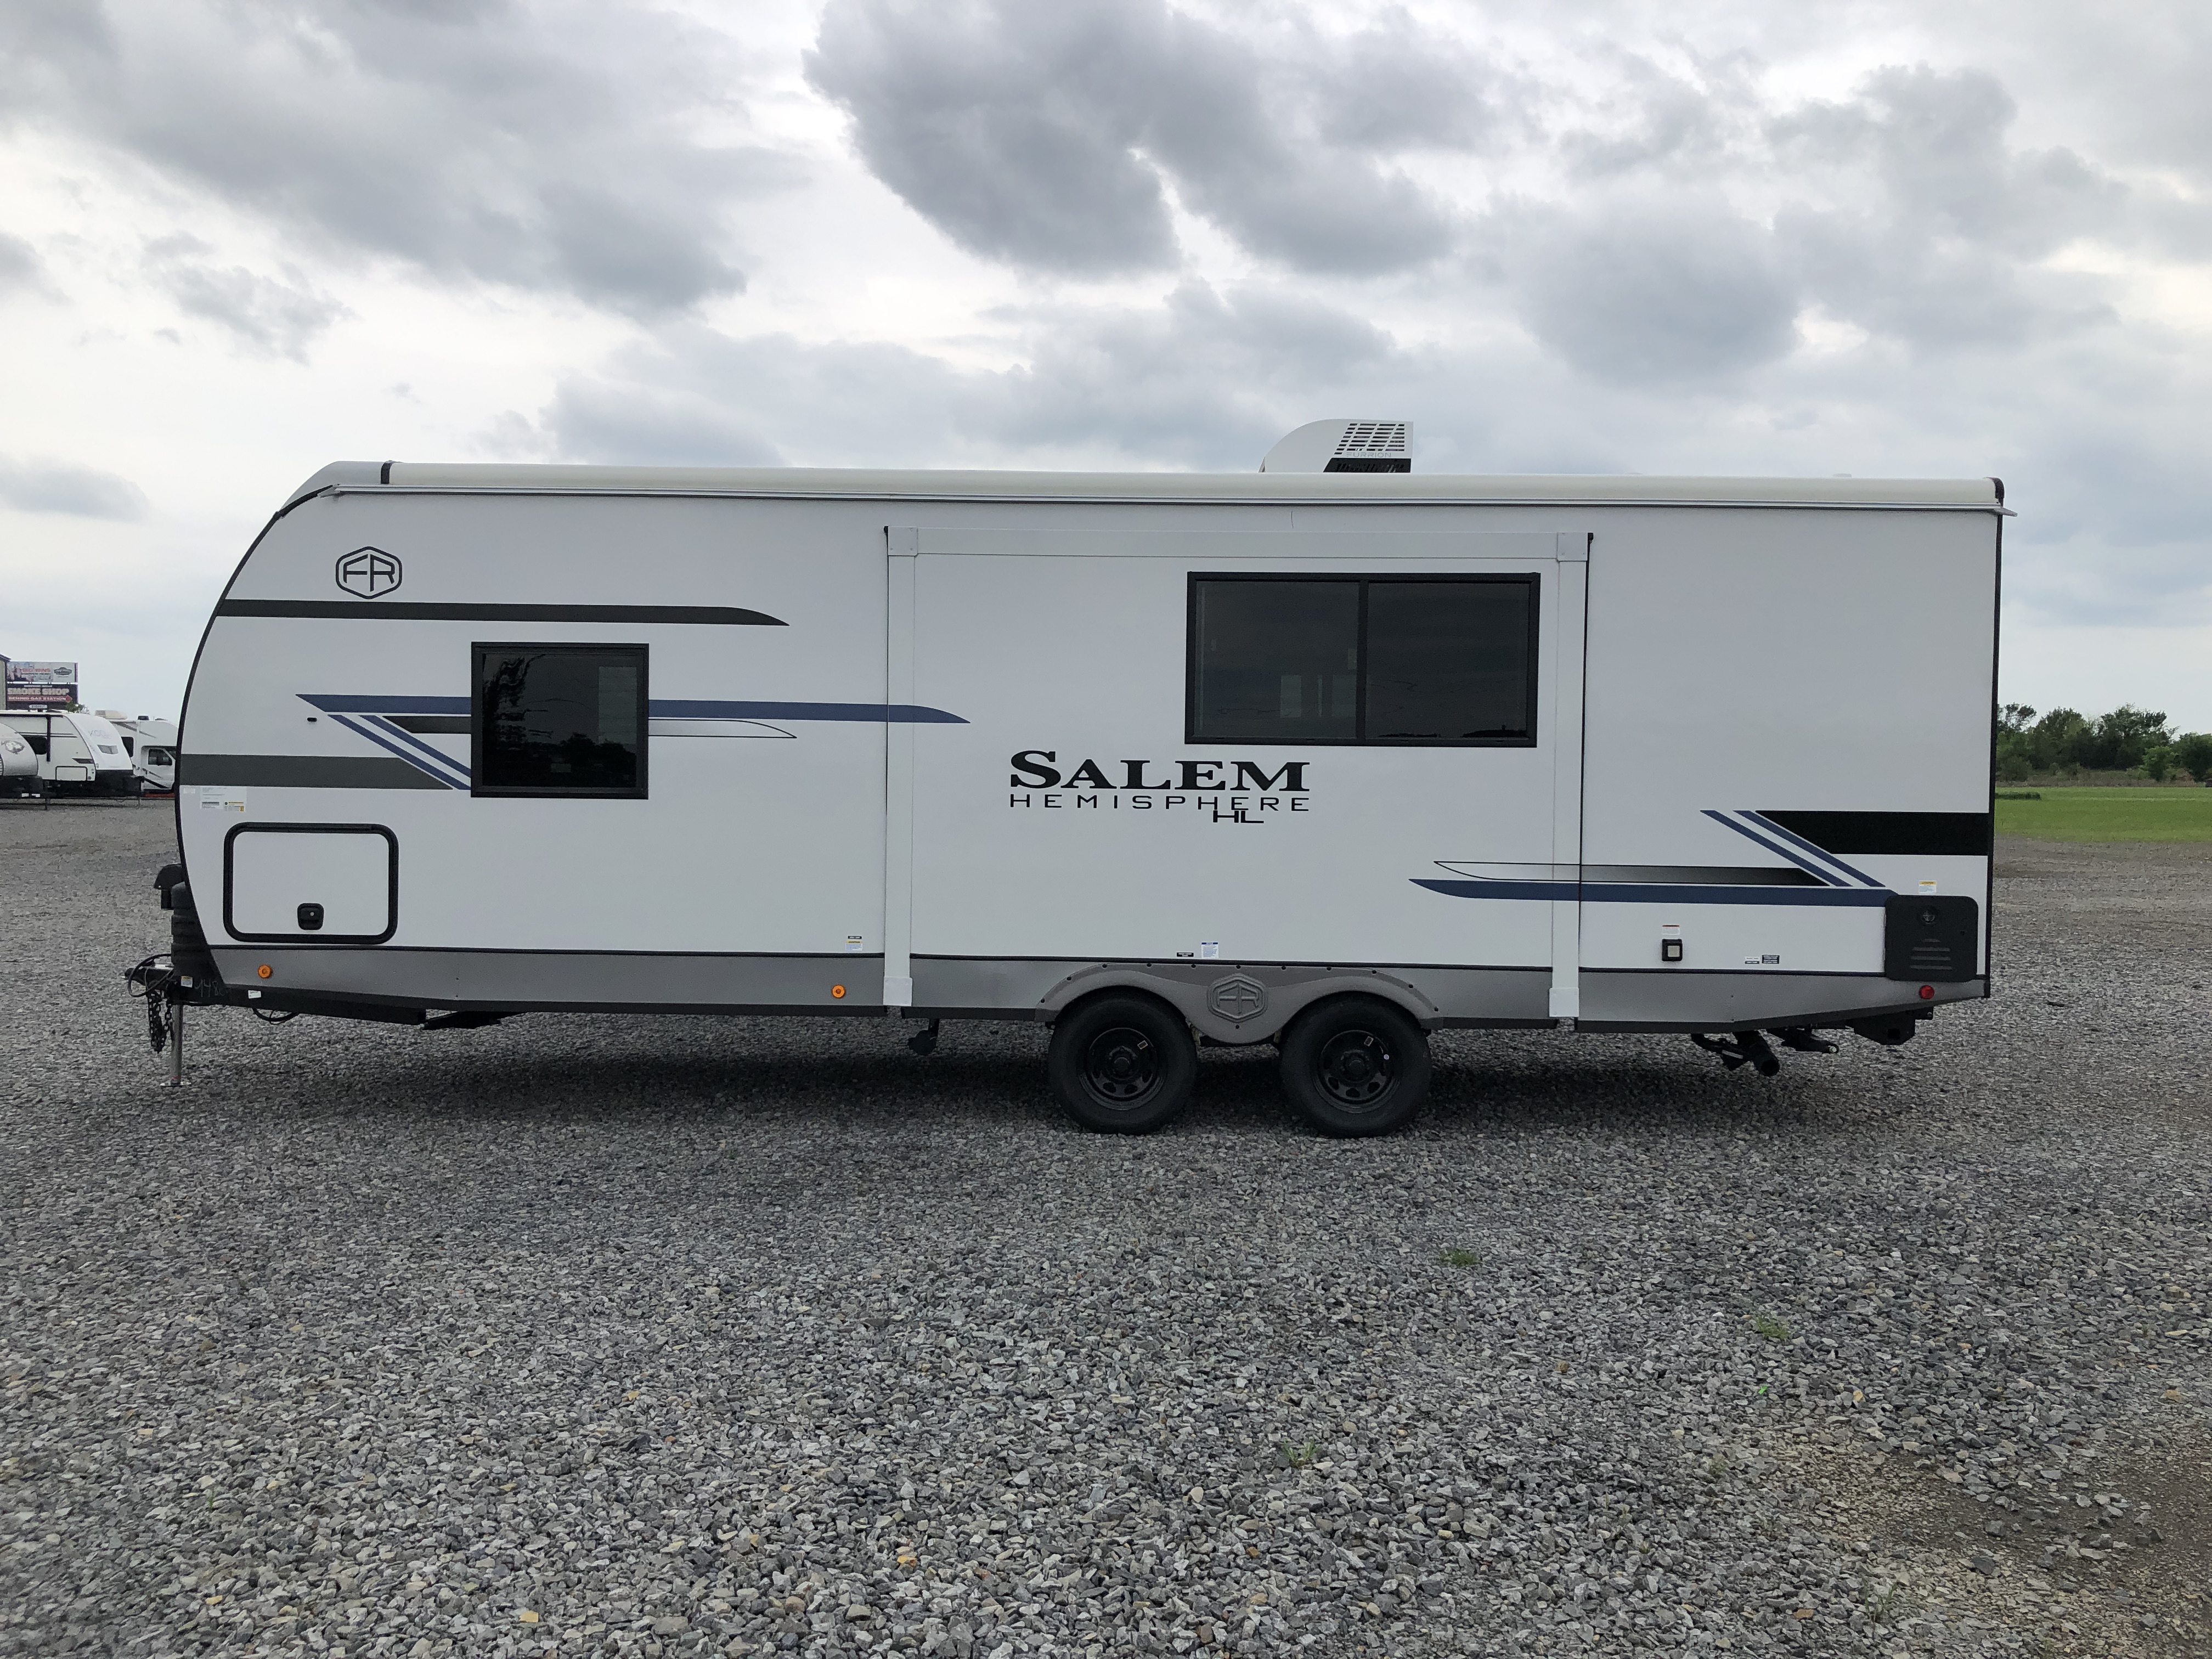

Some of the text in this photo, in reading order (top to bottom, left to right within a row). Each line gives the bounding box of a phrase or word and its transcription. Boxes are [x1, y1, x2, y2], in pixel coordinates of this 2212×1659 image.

[1010, 749, 1310, 792] SALEM
[1010, 793, 1310, 812] HEMISPHERE
[1212, 810, 1264, 823] HL
